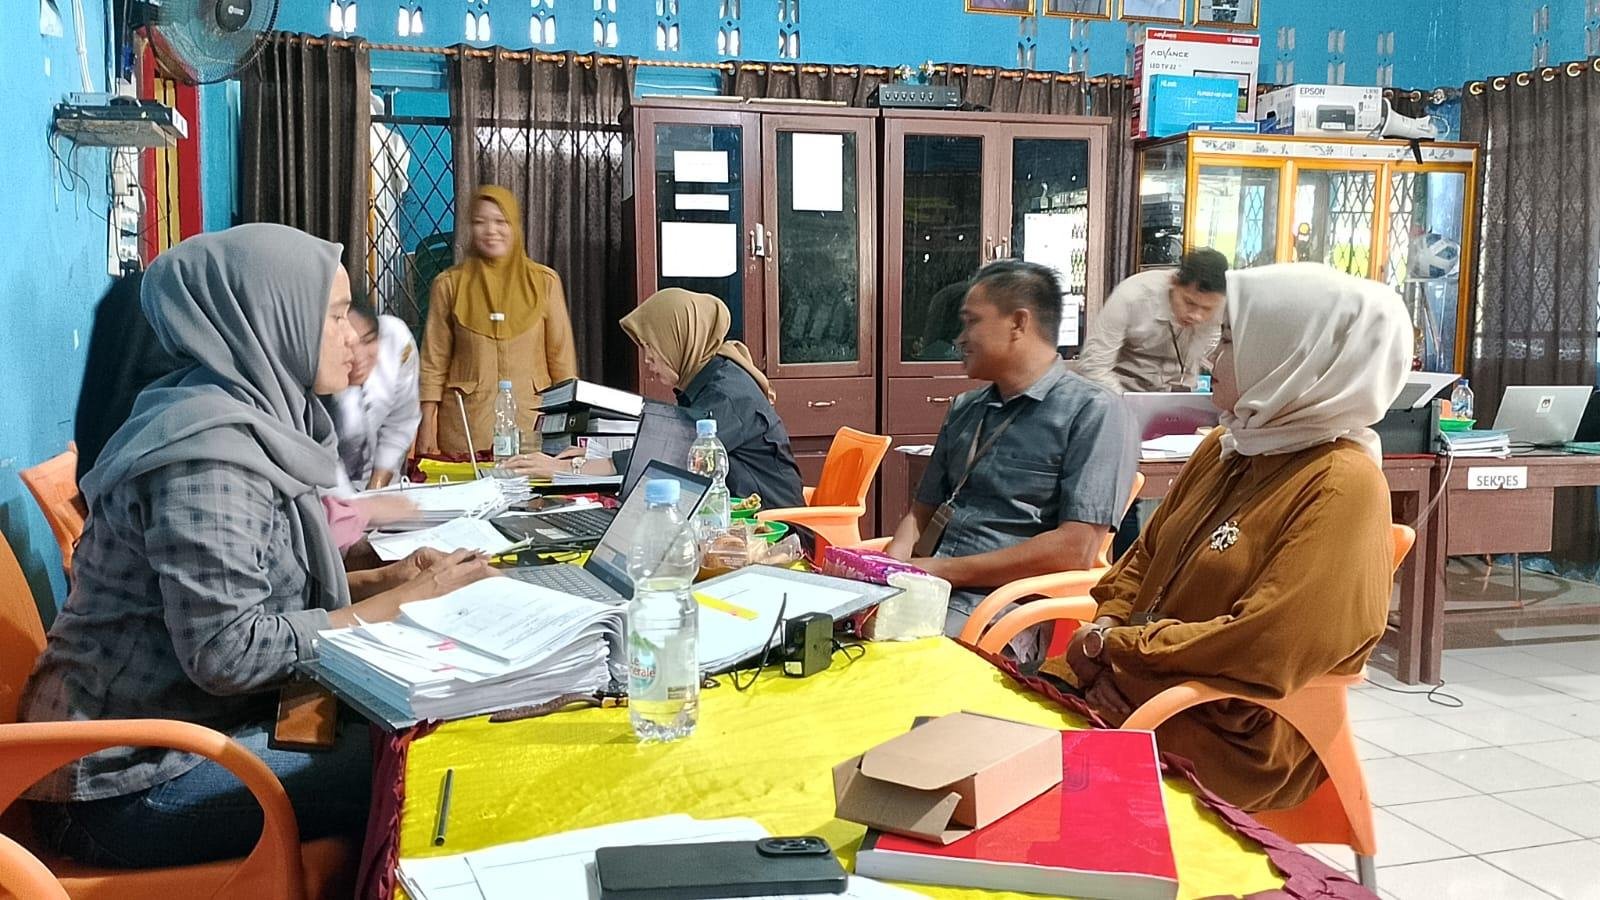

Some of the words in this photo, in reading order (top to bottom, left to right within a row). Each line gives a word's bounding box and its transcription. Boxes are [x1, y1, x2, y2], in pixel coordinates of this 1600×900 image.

[1150, 47, 1189, 59] ADVANCE
[1300, 87, 1326, 96] EPSON
[1476, 475, 1519, 487] SEKDES
